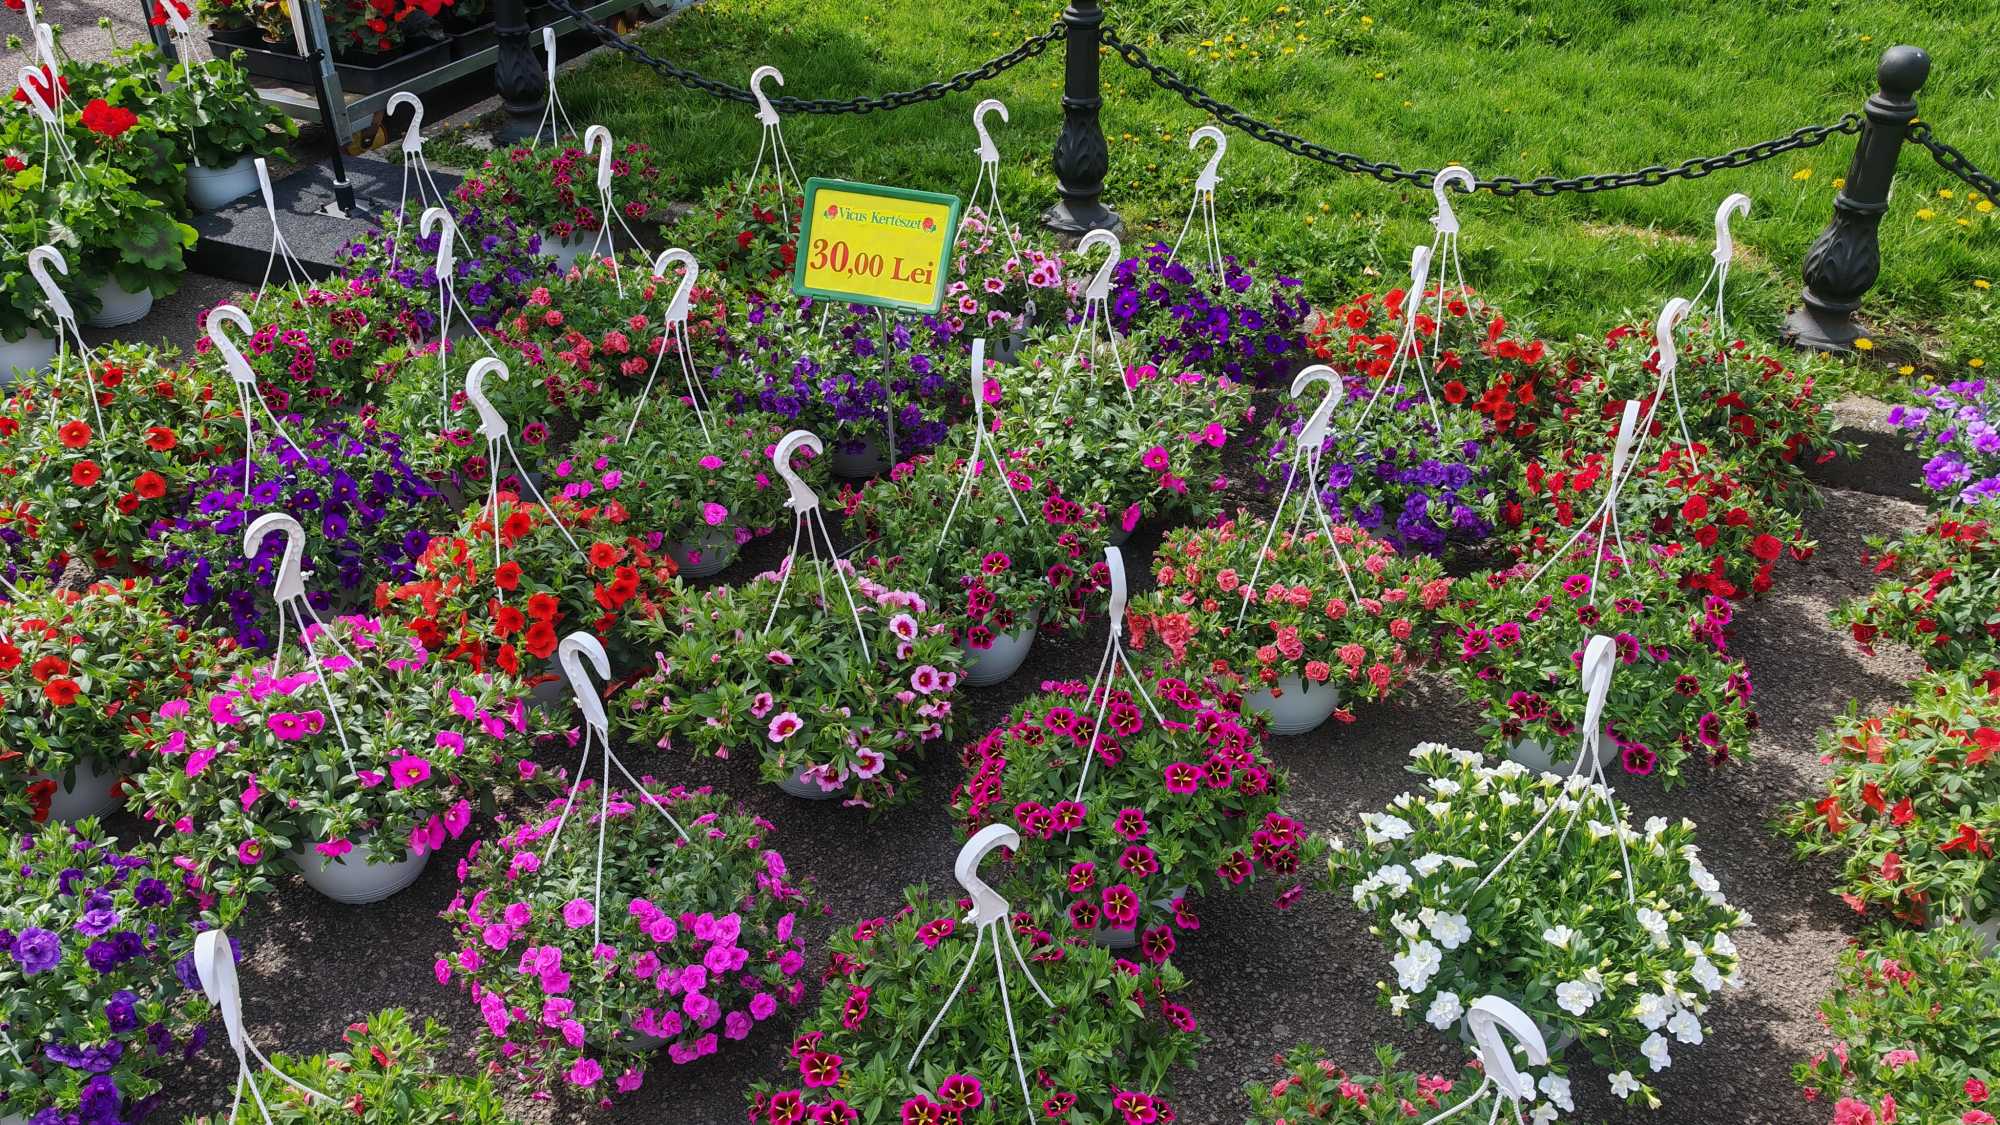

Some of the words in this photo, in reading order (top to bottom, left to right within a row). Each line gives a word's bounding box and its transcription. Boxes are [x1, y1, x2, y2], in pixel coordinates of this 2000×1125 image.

[839, 207, 867, 222] Vicus
[871, 211, 921, 229] Kertészet
[809, 238, 884, 280] 30,00
[890, 257, 934, 285] Lei
